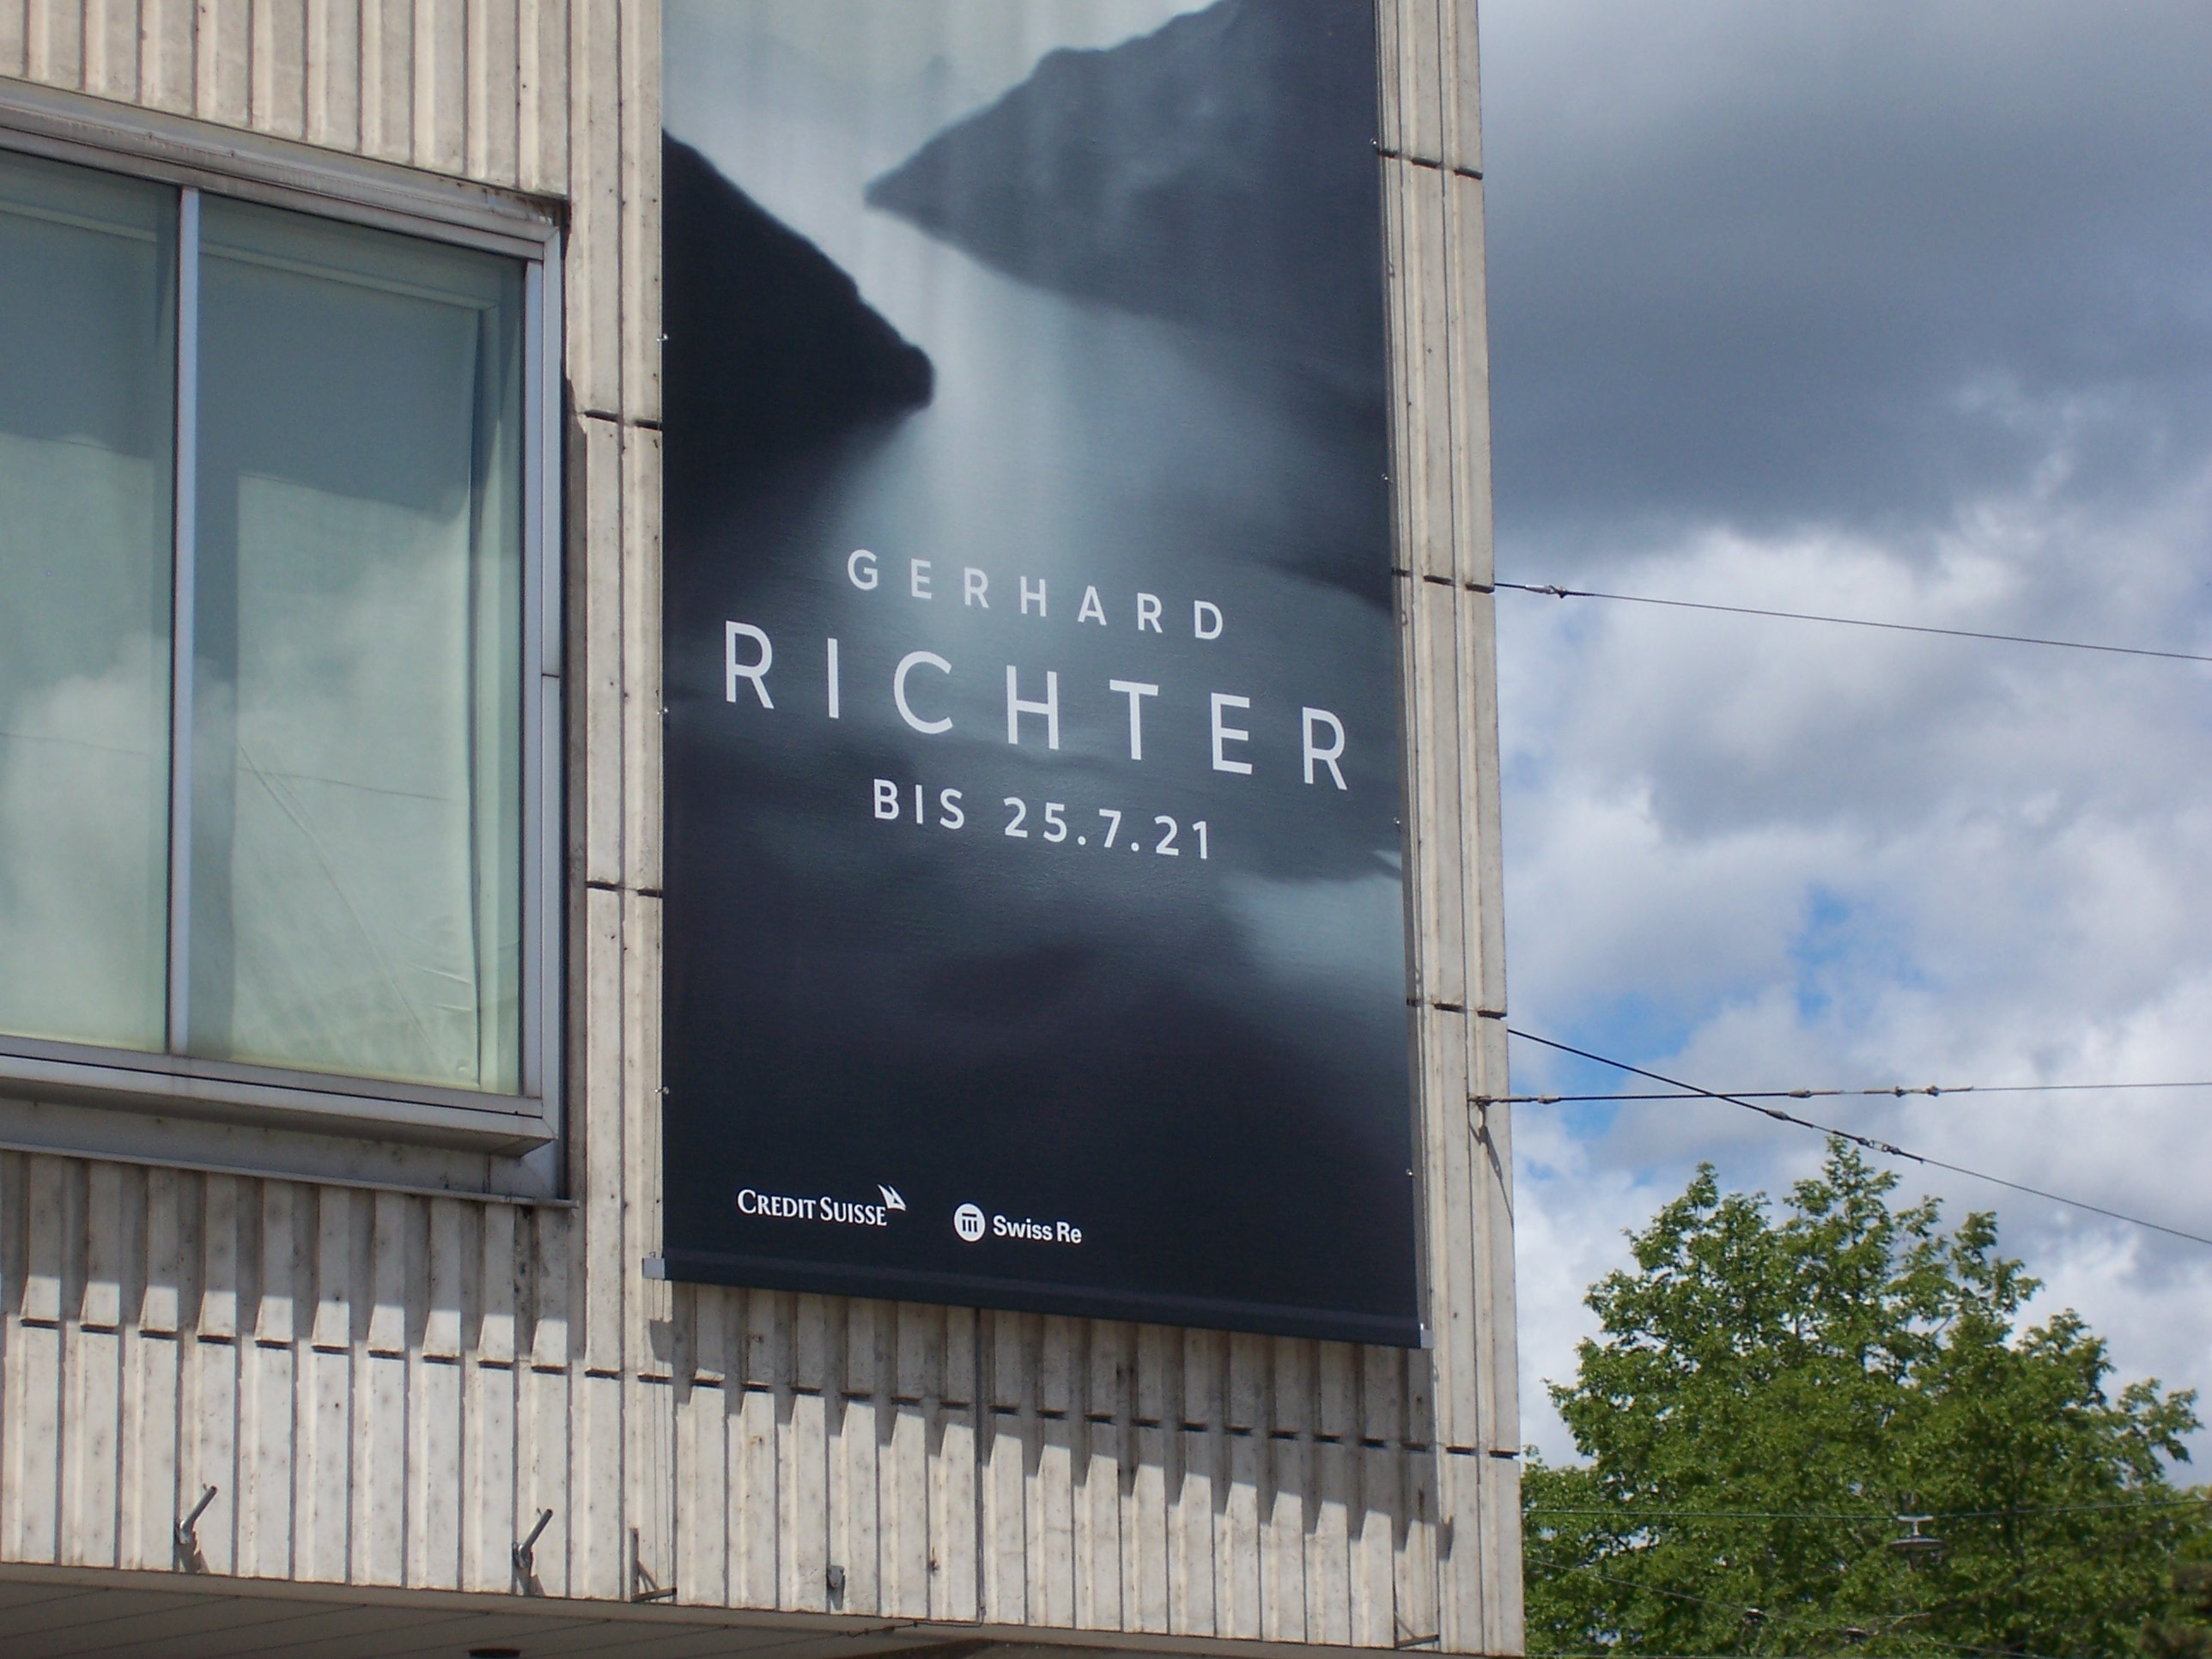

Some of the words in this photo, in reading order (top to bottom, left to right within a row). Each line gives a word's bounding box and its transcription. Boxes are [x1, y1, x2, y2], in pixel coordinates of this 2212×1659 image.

[846, 549, 1224, 641] GERHARD
[724, 620, 1349, 791] RICHTER
[873, 778, 965, 830] BIS
[1003, 796, 1209, 860] 25.7.21
[737, 1188, 817, 1220] CREDIT
[819, 1195, 888, 1227] SUISSE
[993, 1214, 1054, 1242] Swiss
[1056, 1221, 1083, 1244] Re
